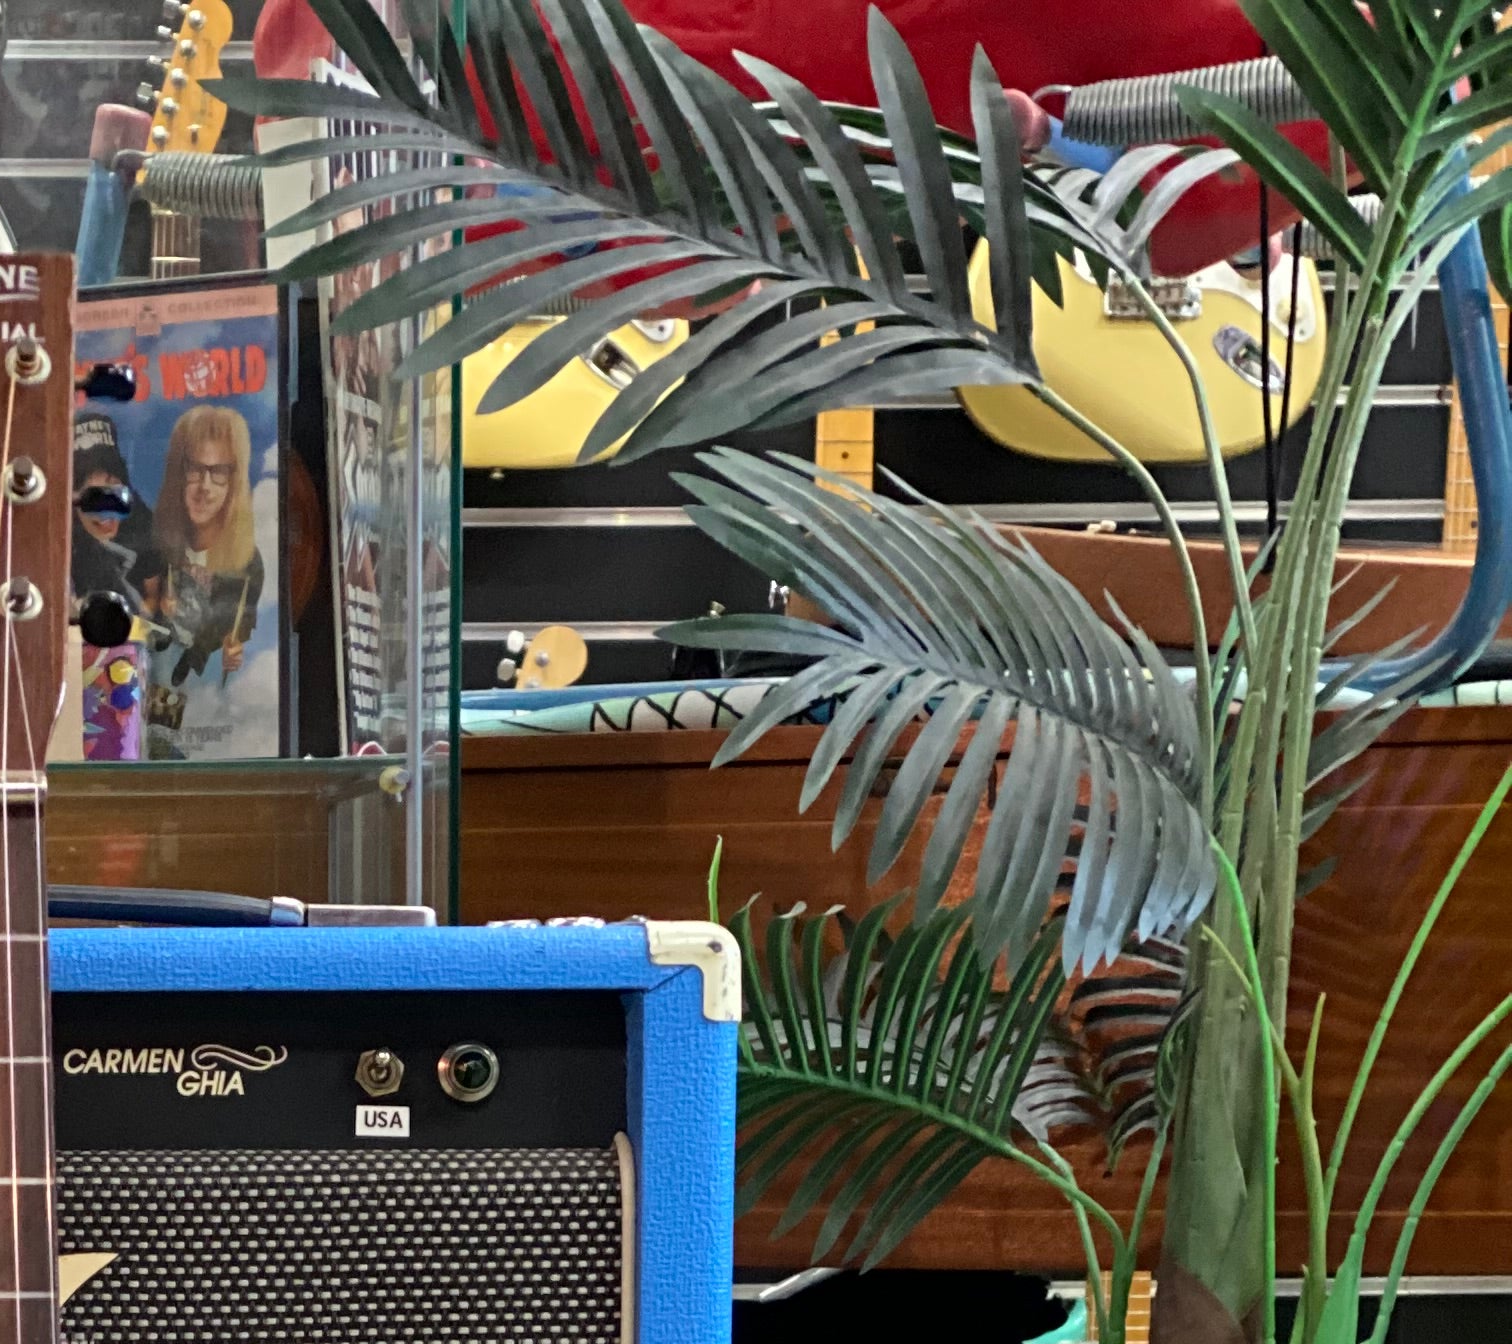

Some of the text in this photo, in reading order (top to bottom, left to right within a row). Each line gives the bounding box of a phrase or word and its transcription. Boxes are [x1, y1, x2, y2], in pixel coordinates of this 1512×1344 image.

[158, 344, 268, 400] WORLD
[63, 1048, 184, 1075] CARMEN
[176, 1070, 245, 1096] GHIA
[363, 1110, 404, 1130] USA
